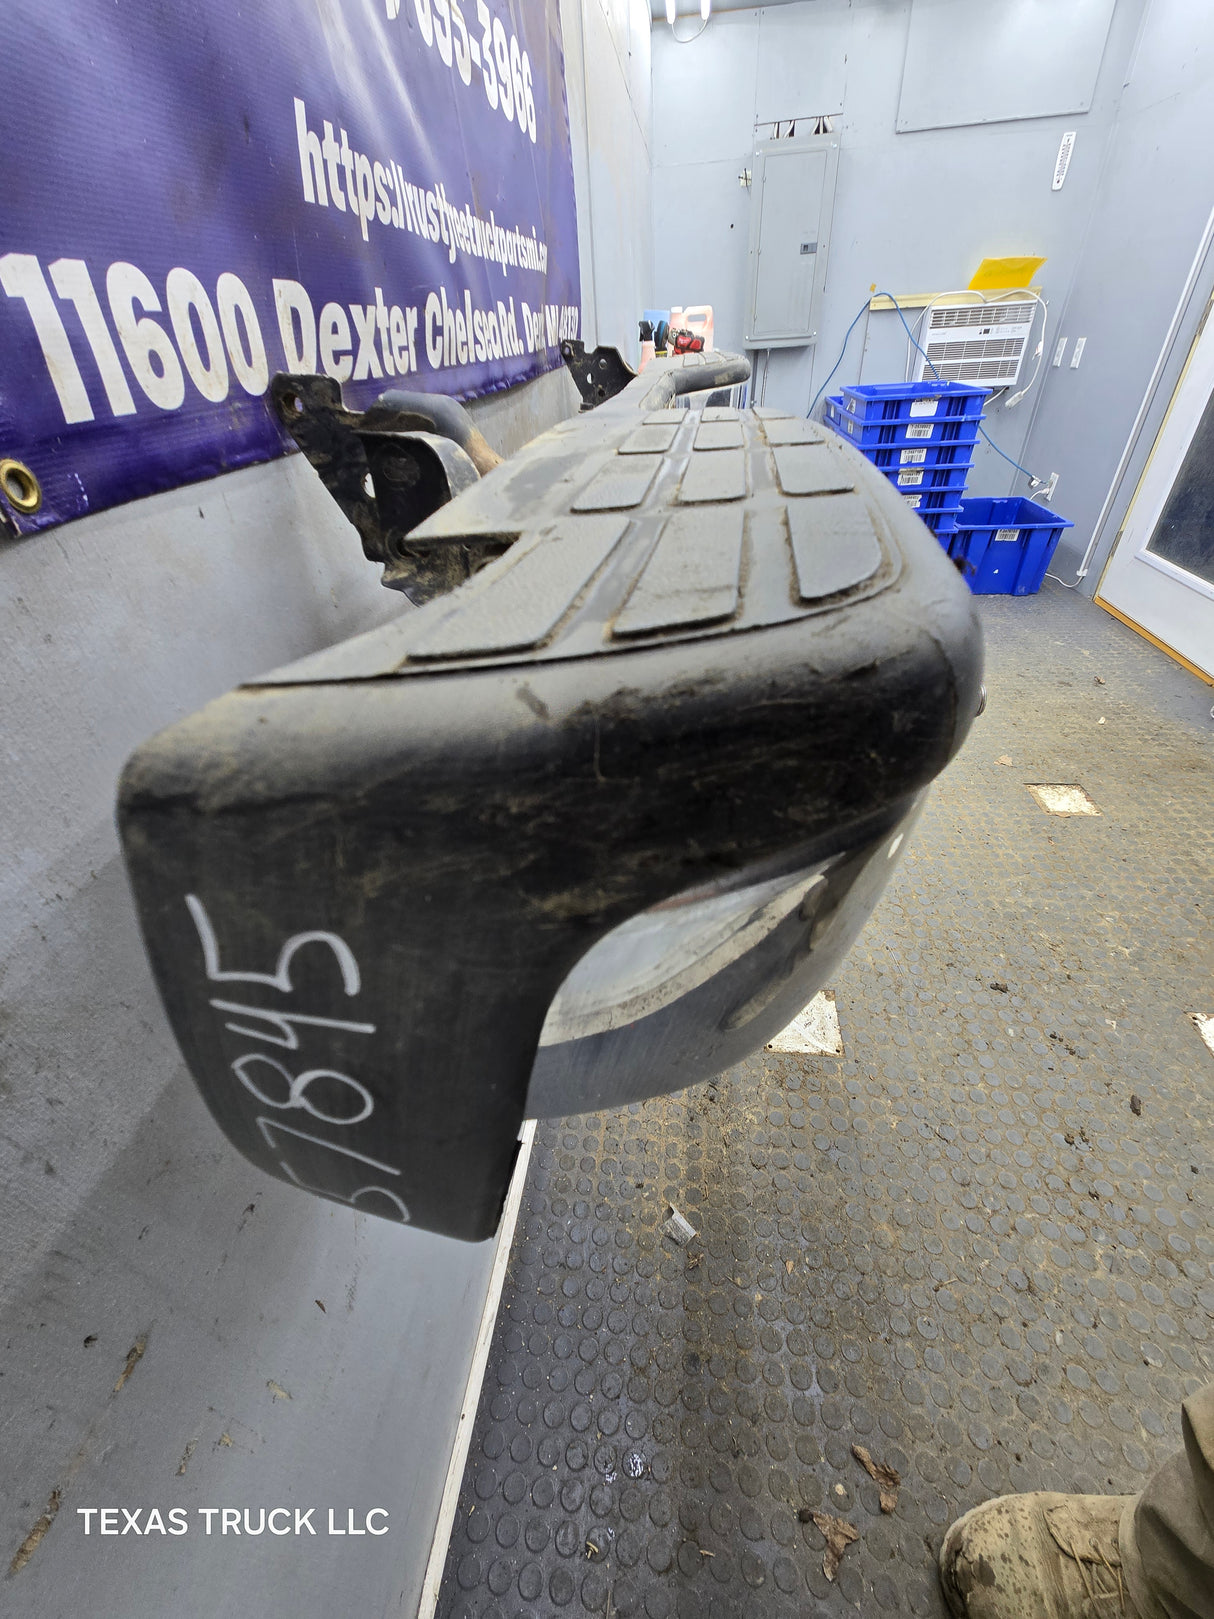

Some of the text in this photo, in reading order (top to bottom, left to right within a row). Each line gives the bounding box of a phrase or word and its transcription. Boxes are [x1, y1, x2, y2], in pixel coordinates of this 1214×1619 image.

[0, 252, 269, 424] 11600
[272, 278, 417, 384] Dexter
[425, 286, 500, 369] Chelsea
[497, 296, 524, 357] Rd.
[184, 893, 411, 1223] 57845
